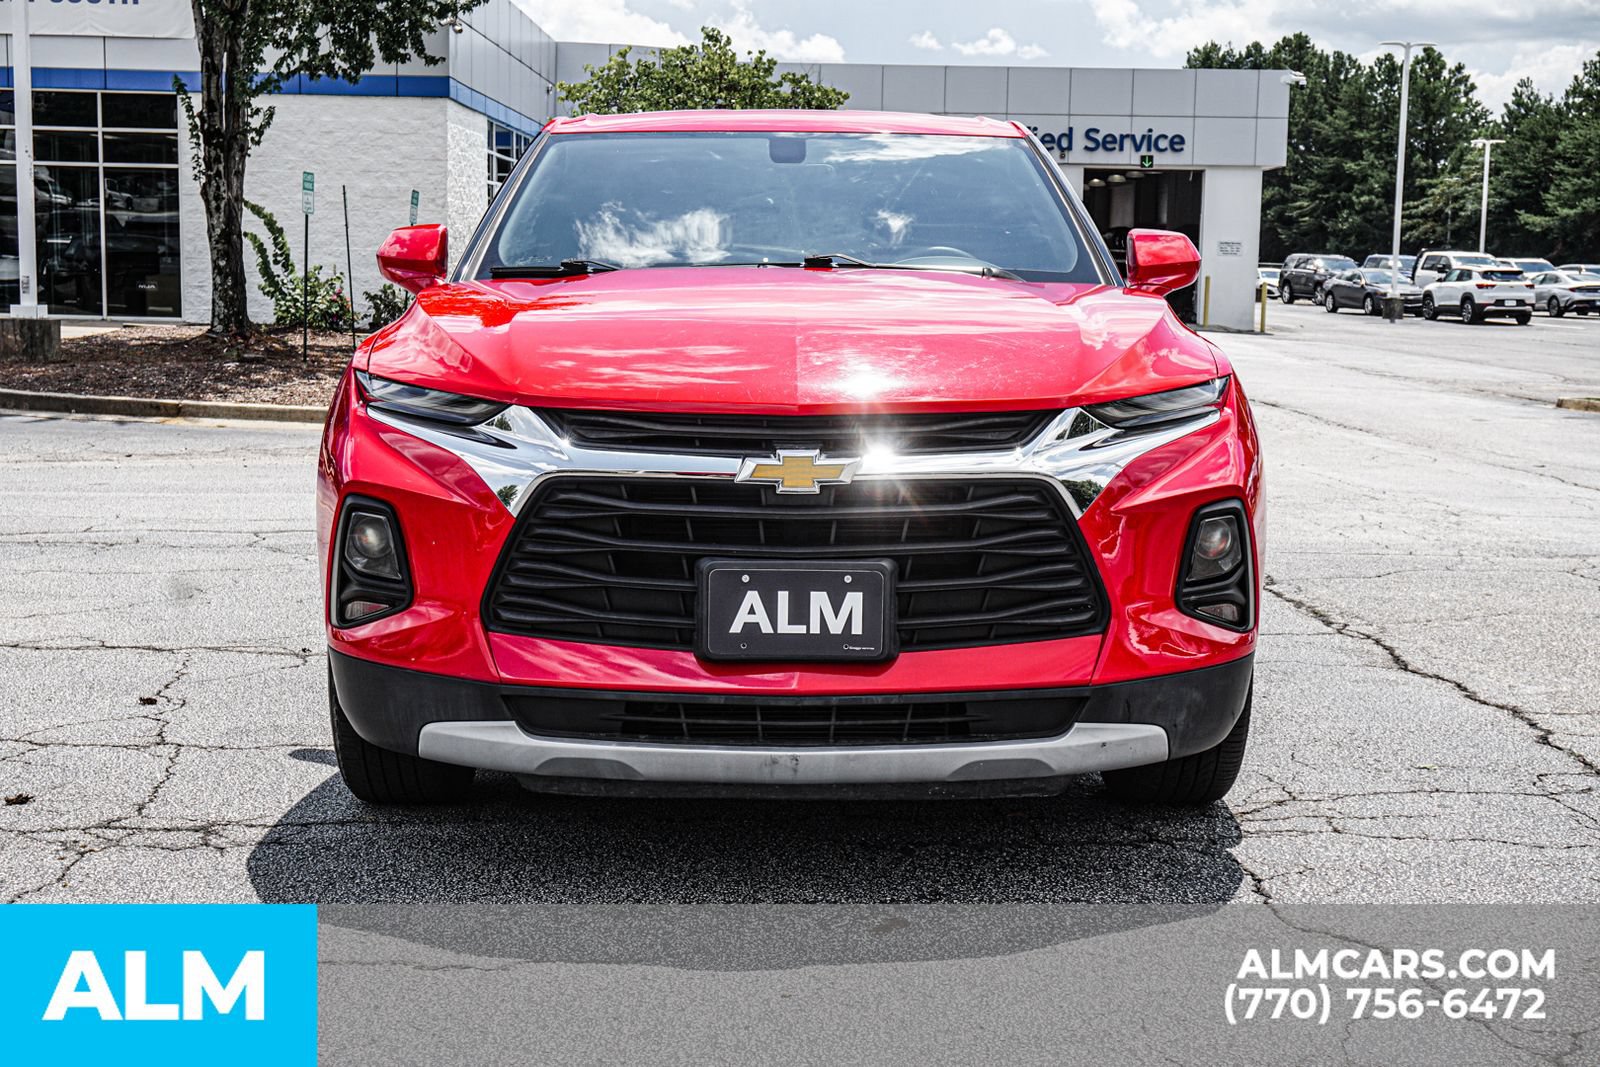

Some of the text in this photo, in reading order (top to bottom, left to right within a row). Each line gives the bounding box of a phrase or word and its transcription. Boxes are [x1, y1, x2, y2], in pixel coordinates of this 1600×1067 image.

[1027, 126, 1186, 153] ed Service
[729, 590, 863, 635] ALM
